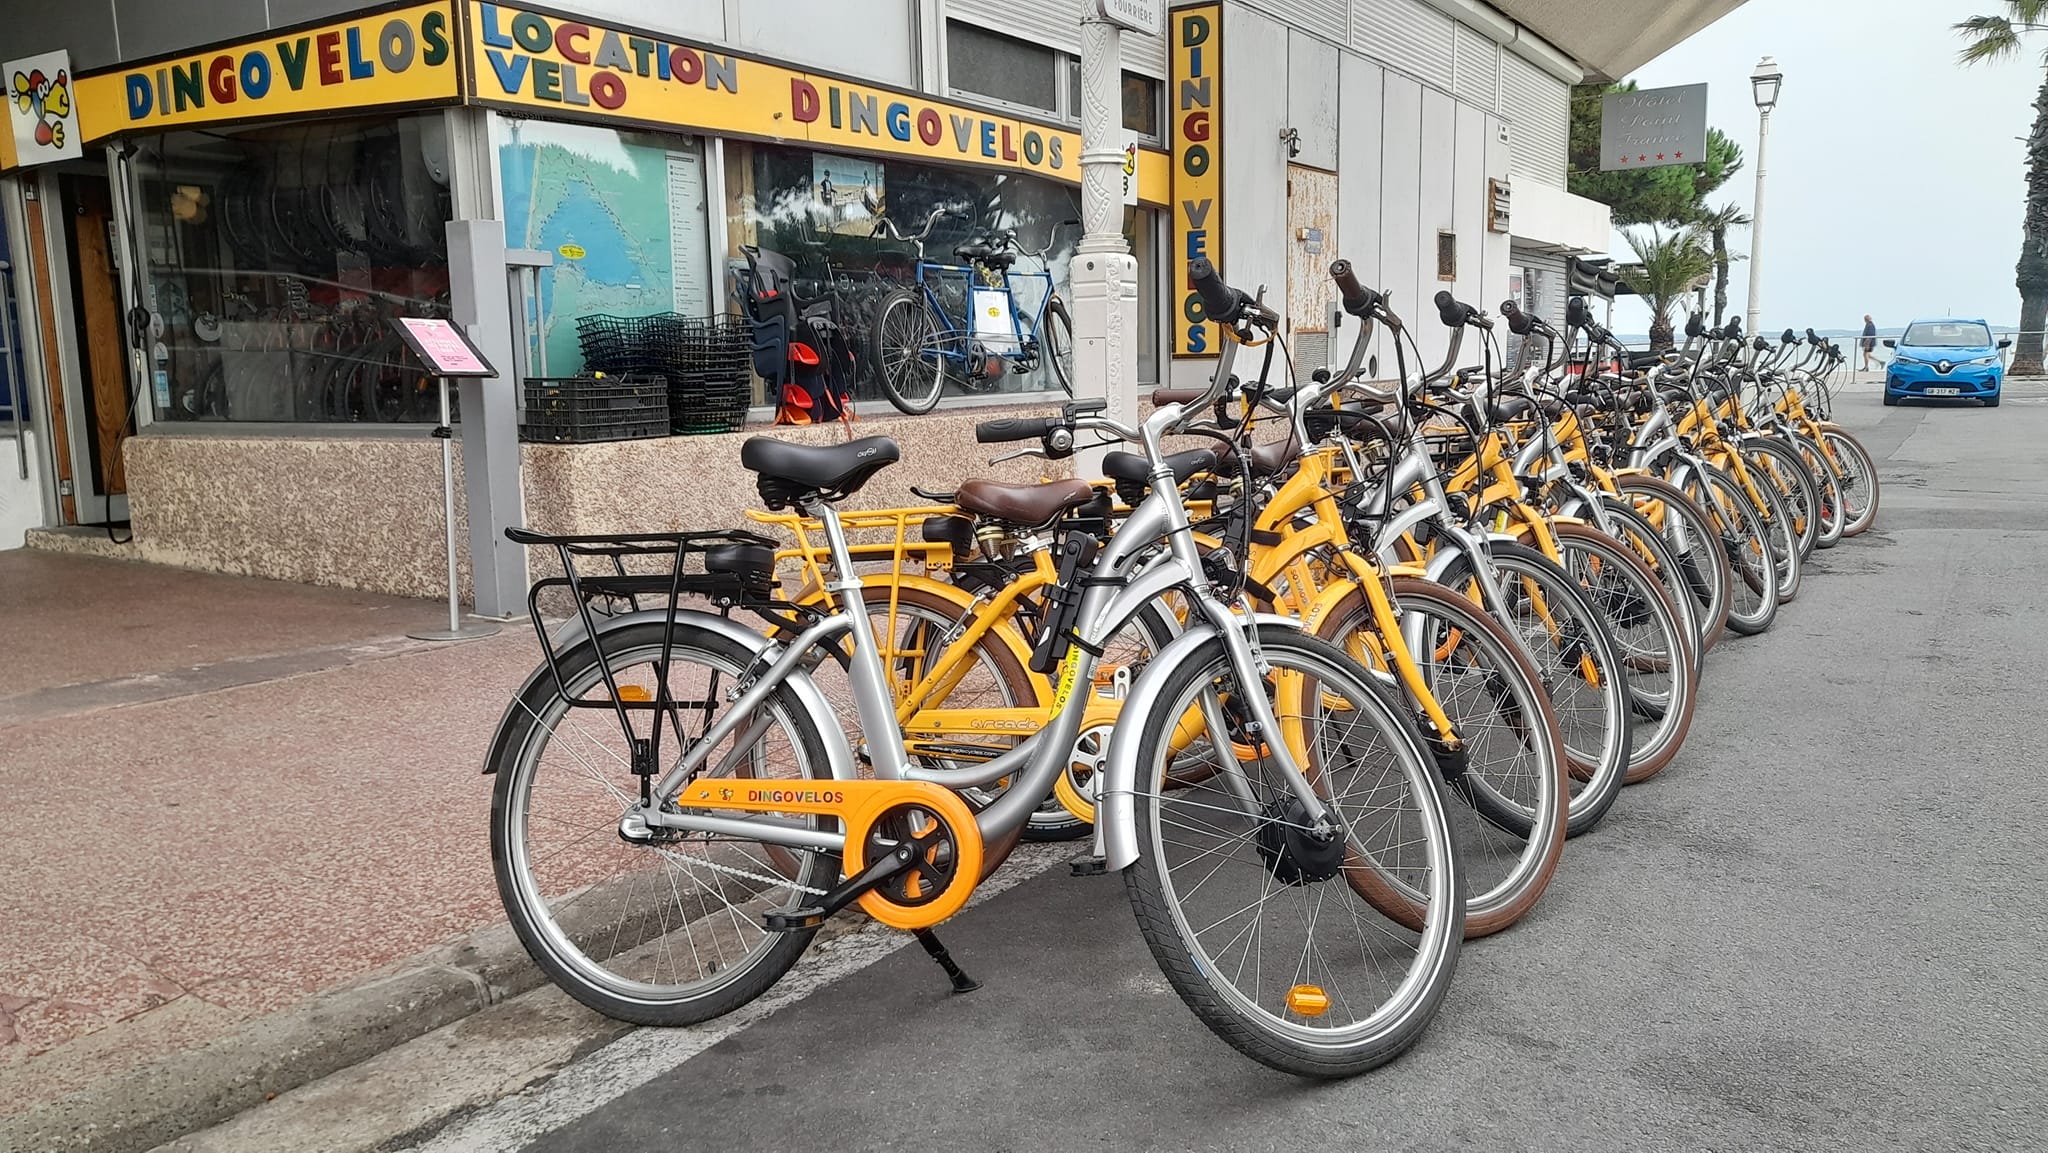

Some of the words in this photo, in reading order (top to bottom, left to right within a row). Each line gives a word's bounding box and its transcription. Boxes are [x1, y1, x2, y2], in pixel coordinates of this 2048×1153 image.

[125, 11, 450, 120] DINGOVELOS
[481, 3, 738, 94] LOCATION
[485, 48, 627, 110] VELO
[790, 77, 1063, 170] DINGOVELOS
[1181, 15, 1211, 177] DINGO
[748, 790, 844, 804] DINGOVELOS
